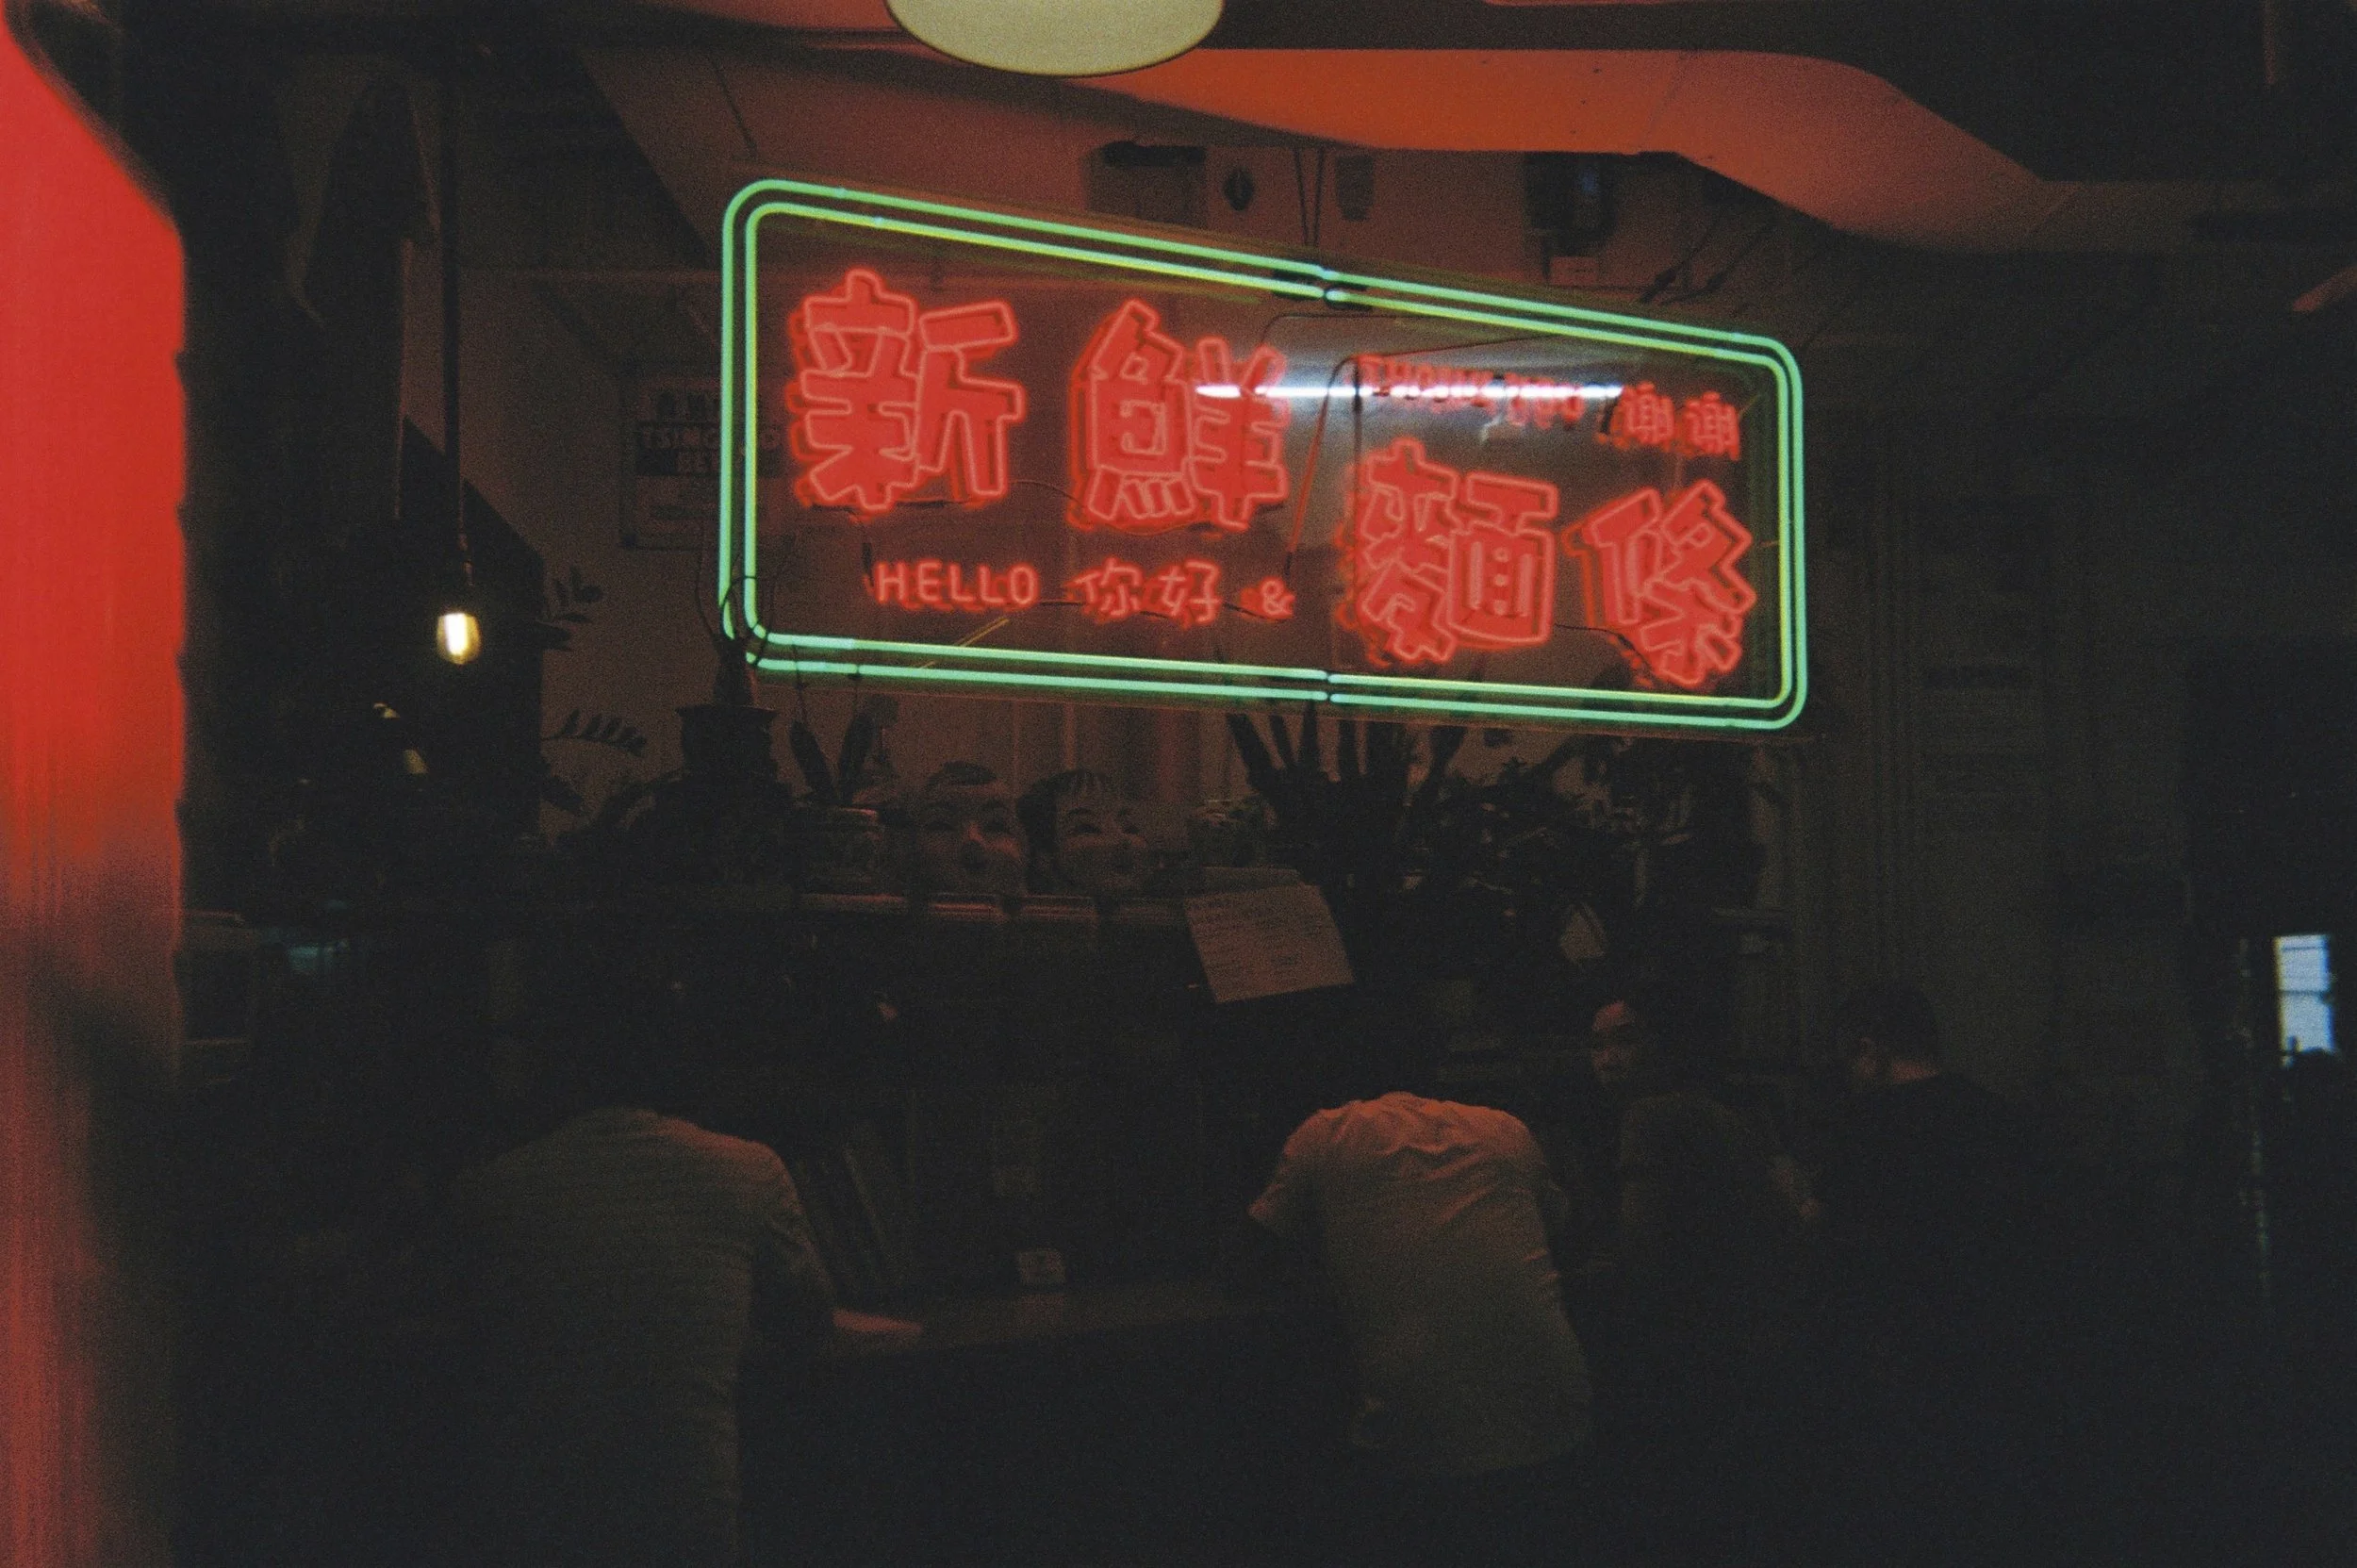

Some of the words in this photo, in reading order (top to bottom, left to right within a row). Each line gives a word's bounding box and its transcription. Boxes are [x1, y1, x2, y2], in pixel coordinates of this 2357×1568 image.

[788, 268, 1292, 533] 新鮮
[874, 561, 1037, 609] HELLO
[1069, 558, 1220, 622] 你好
[1256, 578, 1296, 619] &
